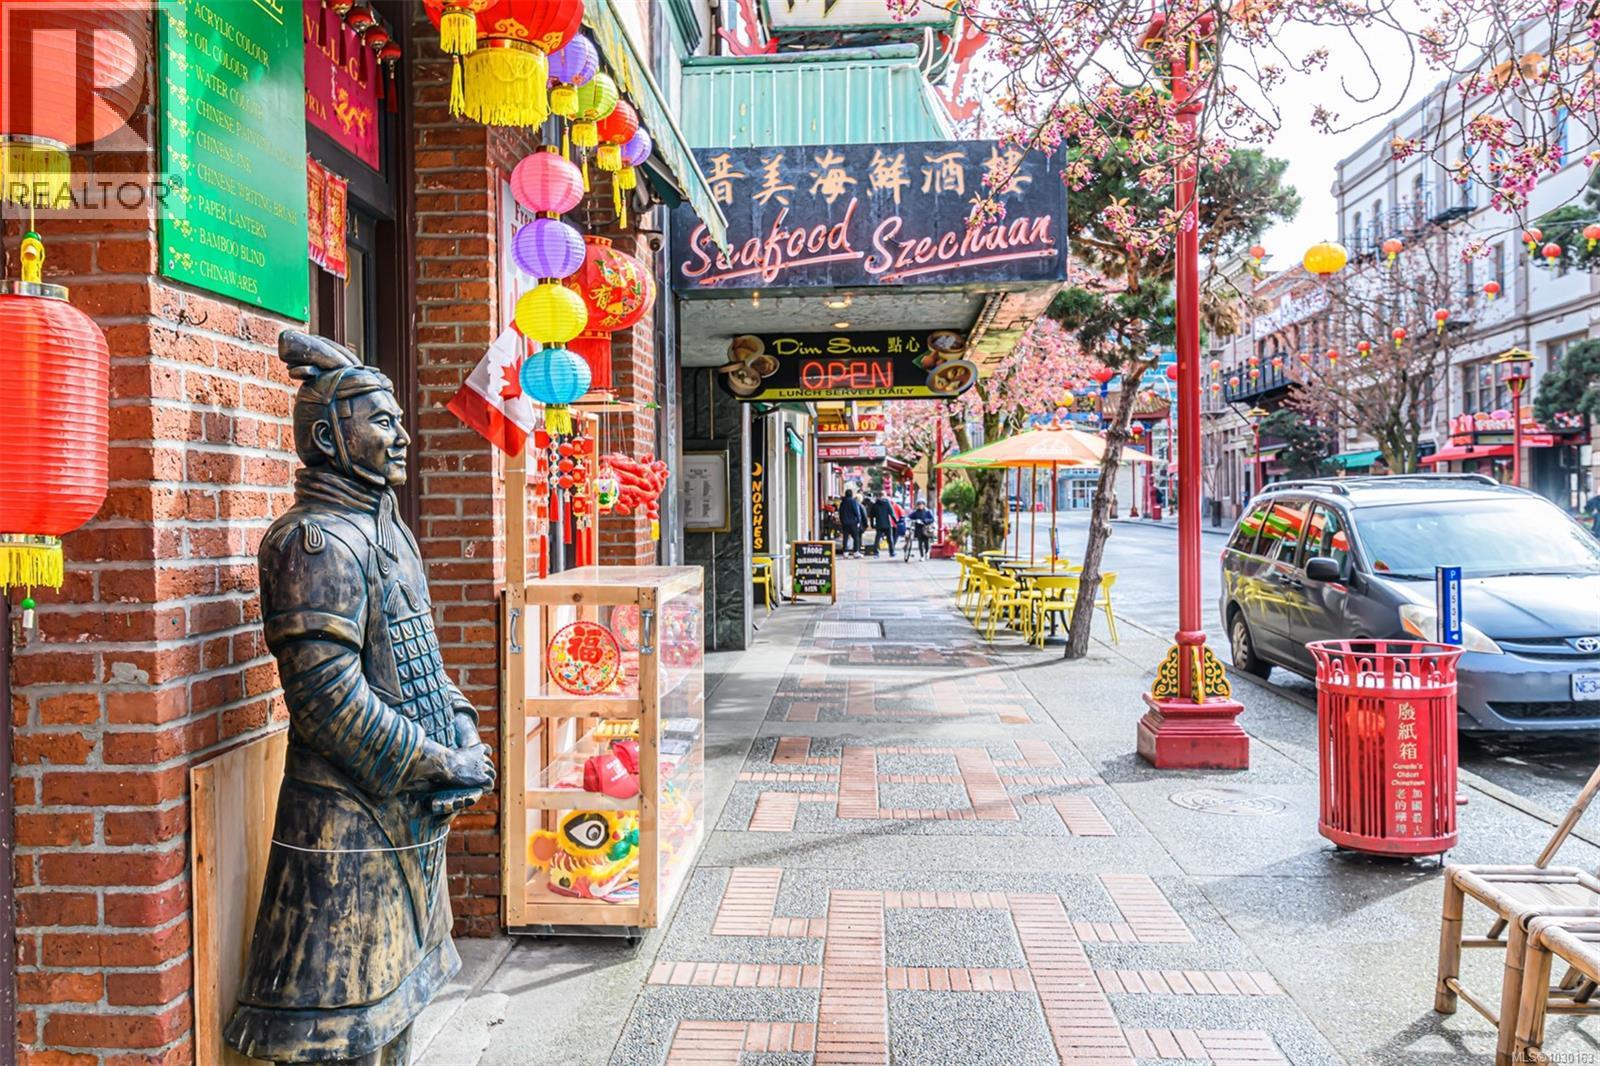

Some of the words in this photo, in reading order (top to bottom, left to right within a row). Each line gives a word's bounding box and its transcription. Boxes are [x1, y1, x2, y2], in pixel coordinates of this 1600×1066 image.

[195, 3, 234, 42] ACRYLIC
[236, 31, 269, 67] COLOUR
[195, 33, 211, 57] OIL
[212, 45, 249, 82] COLOUR
[196, 64, 229, 99] WATER
[196, 98, 236, 135] CHINESE
[196, 130, 236, 165] CHINESE
[197, 162, 237, 196] CHINESE
[198, 195, 228, 222] PAPER
[229, 208, 268, 239] LANTERN
[200, 228, 240, 258] BAMBOO
[240, 244, 266, 268] BLIND
[681, 197, 859, 283] Seafood
[863, 214, 1054, 275] Szechuan
[200, 260, 259, 295] CHINAWARES
[772, 338, 822, 355] Dim
[826, 337, 881, 354] Sum
[887, 336, 920, 353] 點心
[779, 389, 822, 397] LUNCH
[878, 387, 915, 395] DAILY
[802, 361, 894, 389] OPEN
[752, 481, 763, 549] NOCHES
[567, 625, 603, 664] 福
